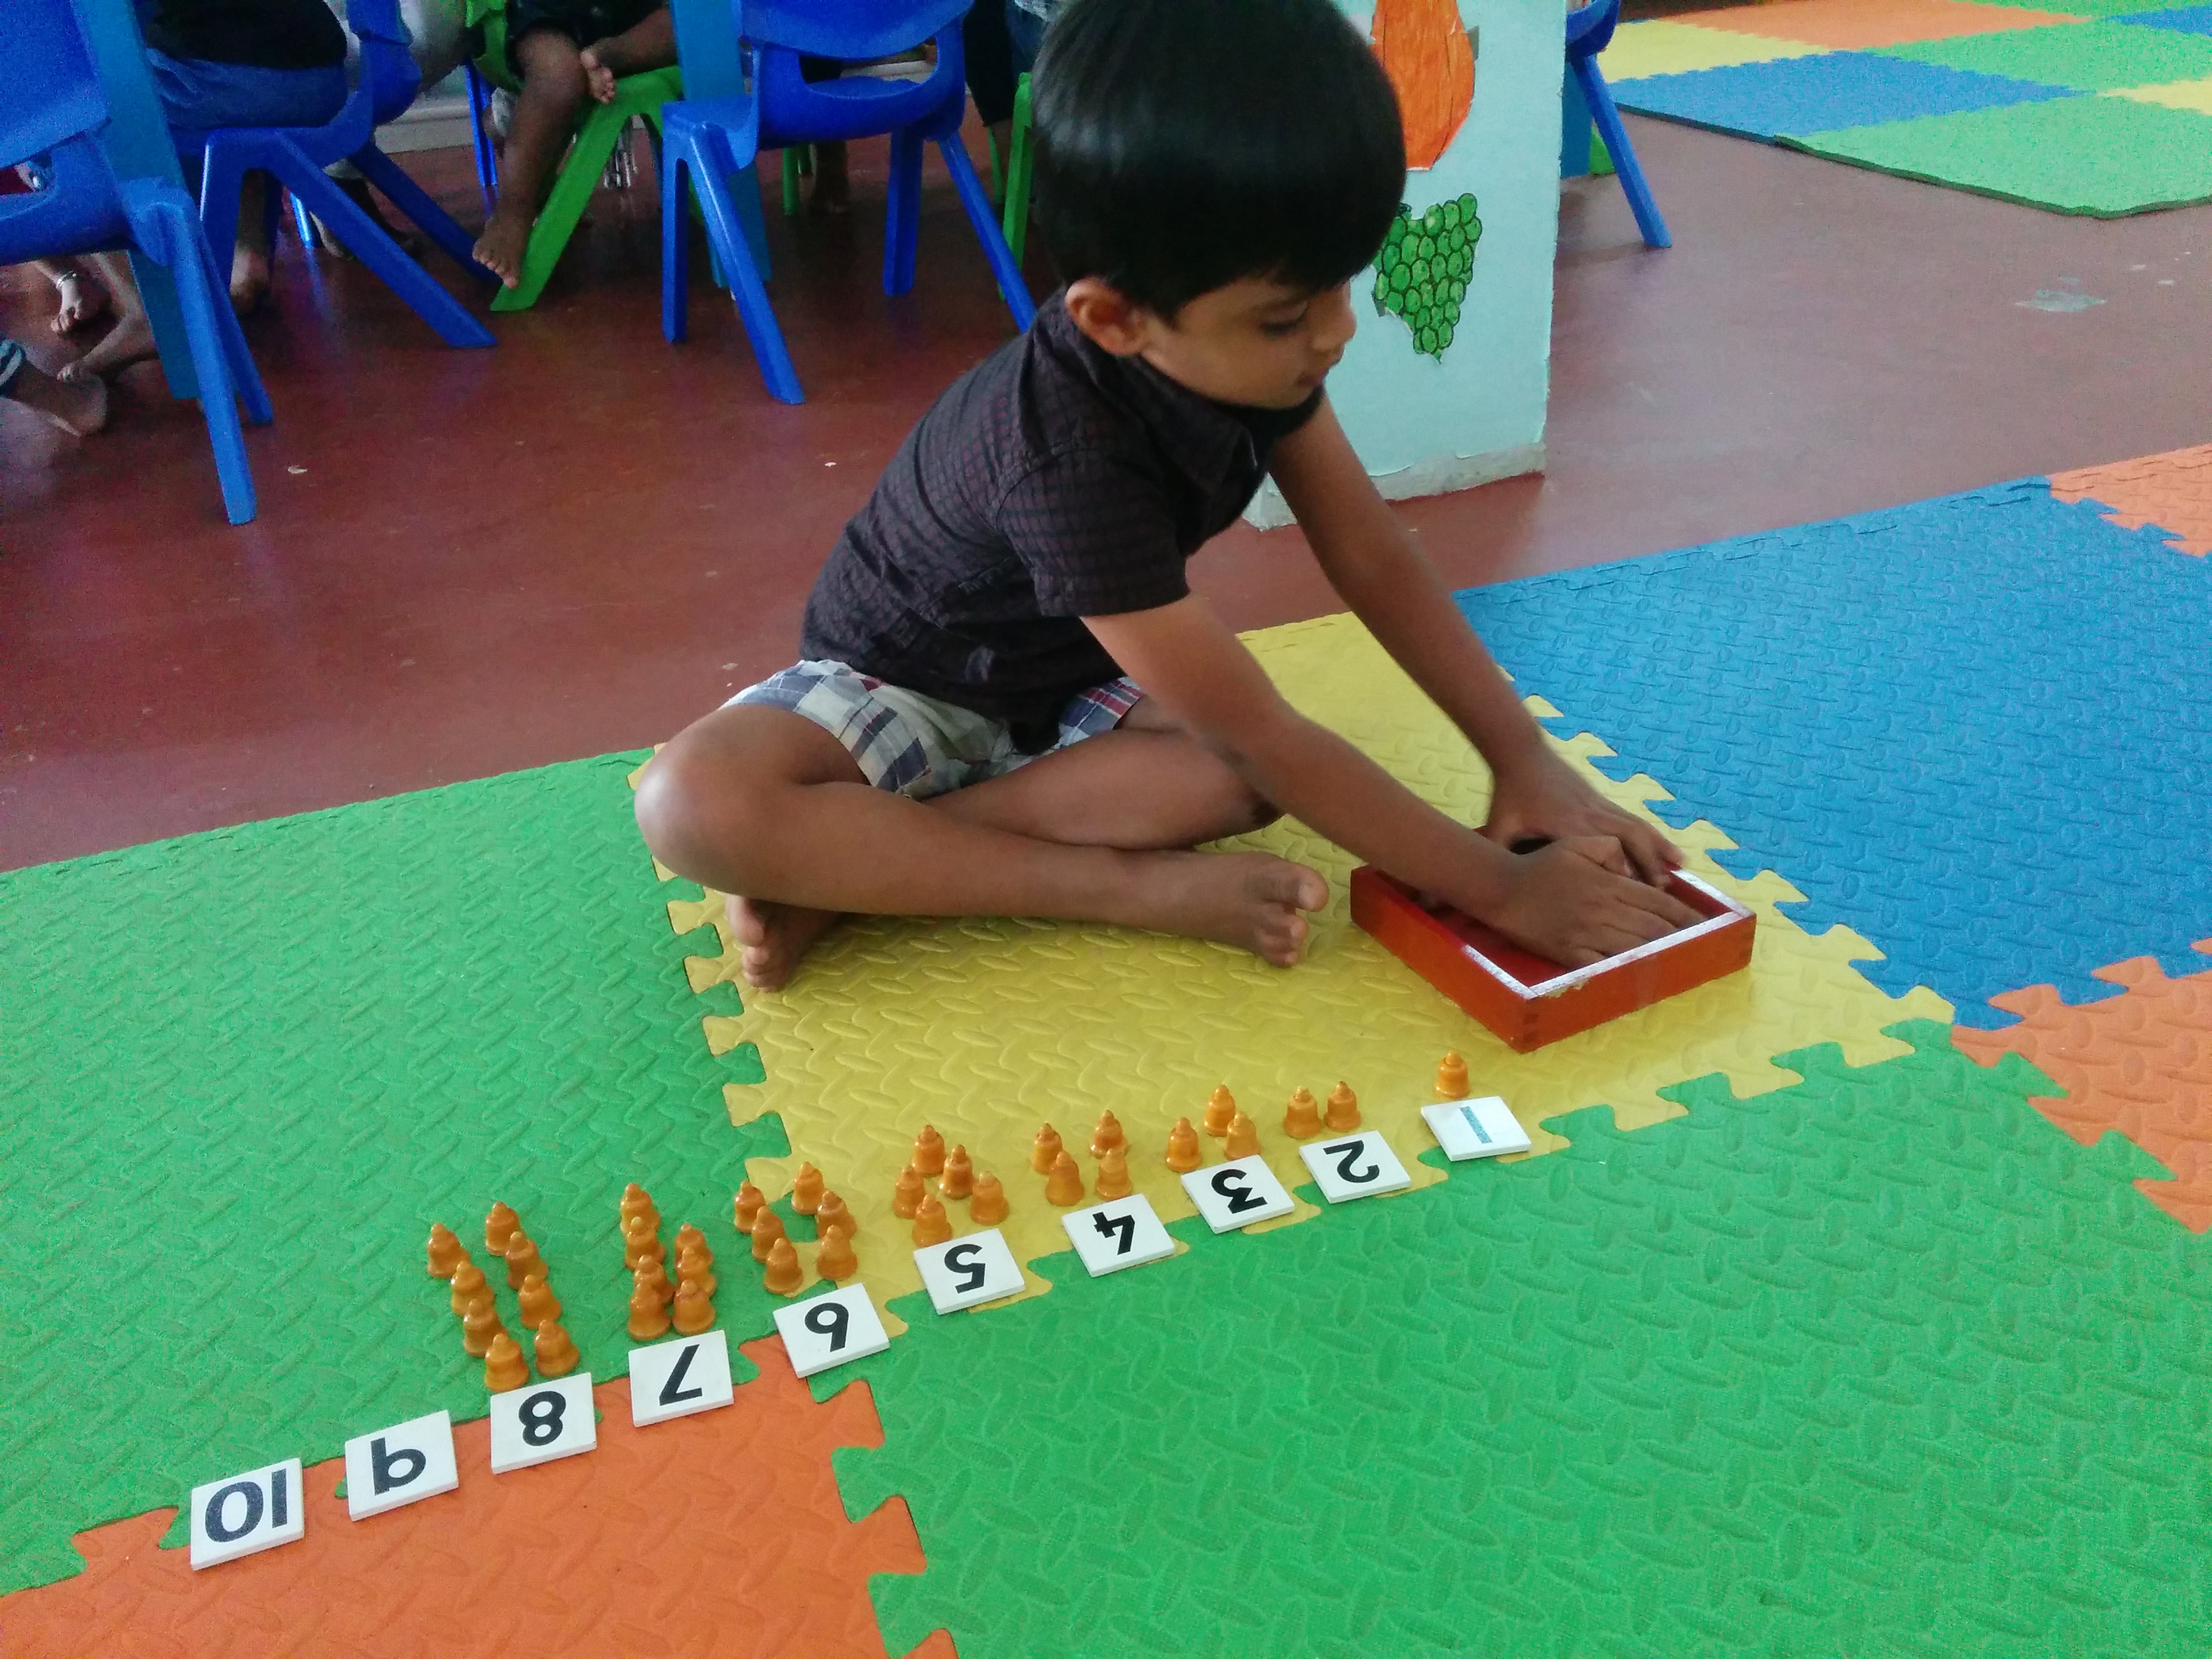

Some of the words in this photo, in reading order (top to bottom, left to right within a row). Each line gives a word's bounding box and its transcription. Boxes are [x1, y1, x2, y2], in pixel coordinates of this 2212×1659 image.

[1460, 1106, 1492, 1144] 1
[1323, 1140, 1380, 1183] 2
[1211, 1168, 1268, 1214] 3
[1092, 1212, 1136, 1255] 4
[944, 1244, 986, 1294] 5
[804, 1303, 849, 1353] 6
[659, 1344, 703, 1406] 7
[518, 1391, 567, 1446] 8
[371, 1437, 426, 1495] 9
[205, 1469, 288, 1542] 10
